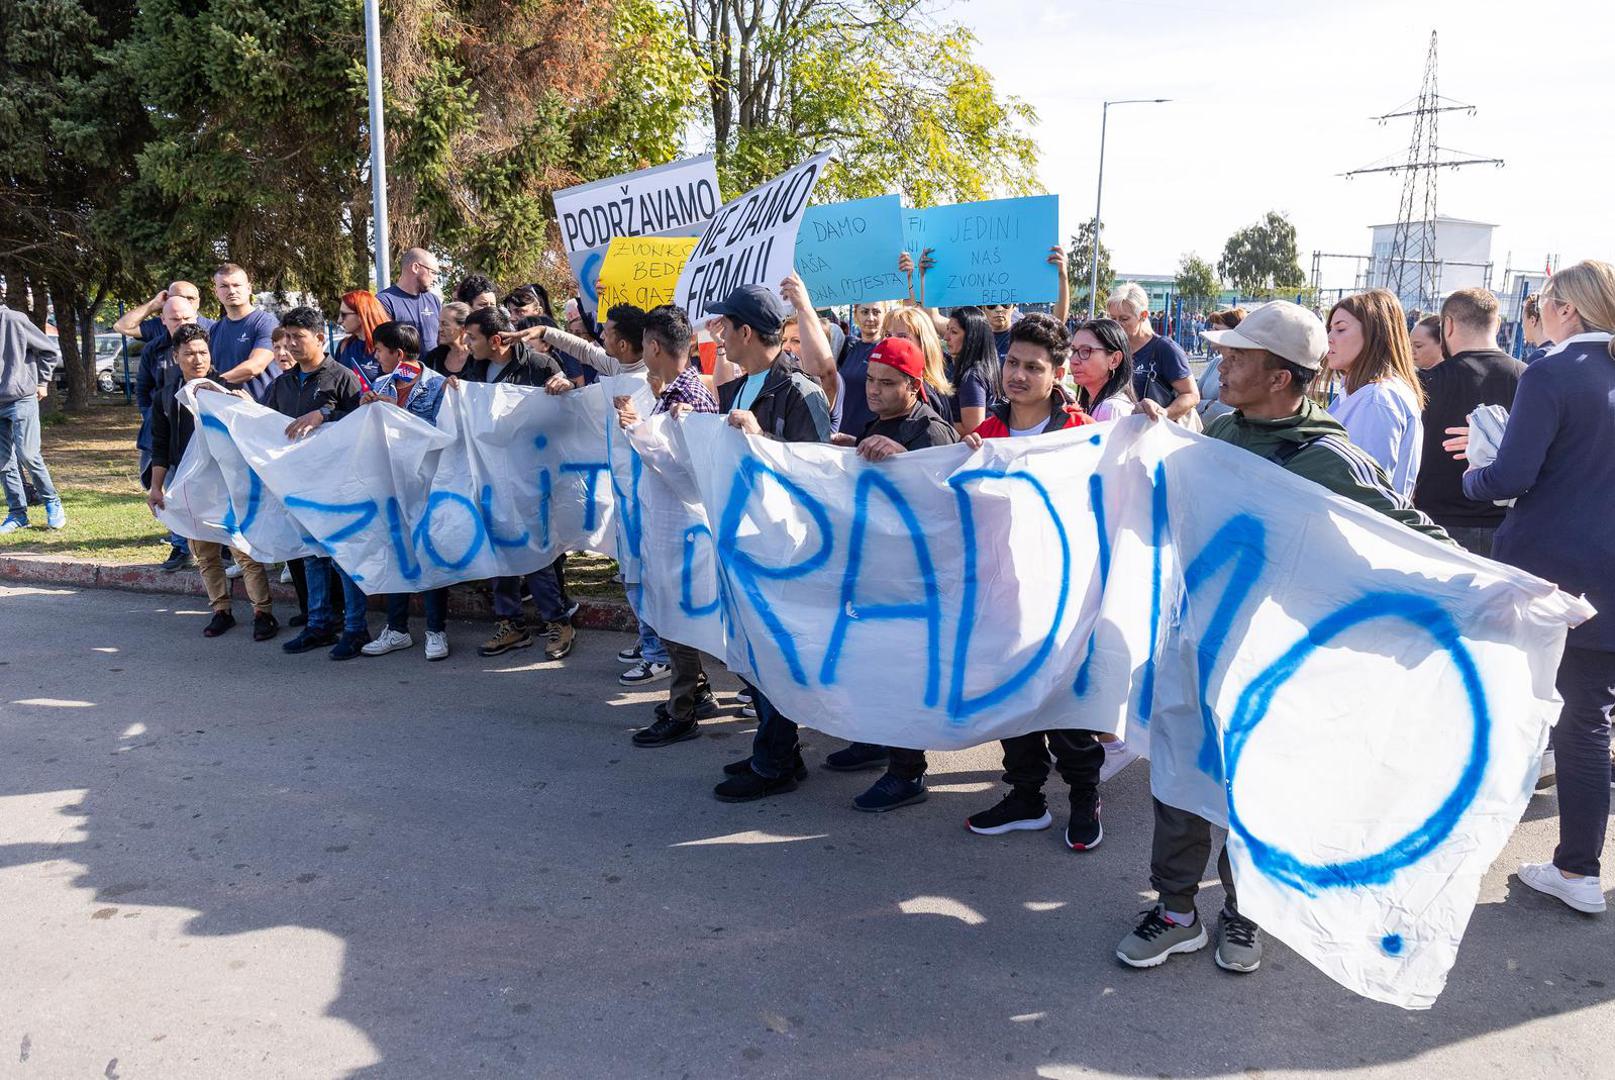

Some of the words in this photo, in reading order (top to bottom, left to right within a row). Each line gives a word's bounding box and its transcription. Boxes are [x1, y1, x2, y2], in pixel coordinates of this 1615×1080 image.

[563, 179, 716, 252] PODRŽAVAMO
[690, 204, 740, 262] NE
[725, 164, 817, 247] DAMO
[813, 217, 867, 243] DAMO
[950, 214, 1020, 243] JEDINI
[613, 241, 695, 258] ZVONKO
[971, 247, 1001, 266] NAŠ
[841, 272, 904, 301] MJESTA
[947, 272, 1010, 289] ZVONKO
[601, 282, 629, 307] NAŠ
[982, 288, 1018, 304] BEDE
